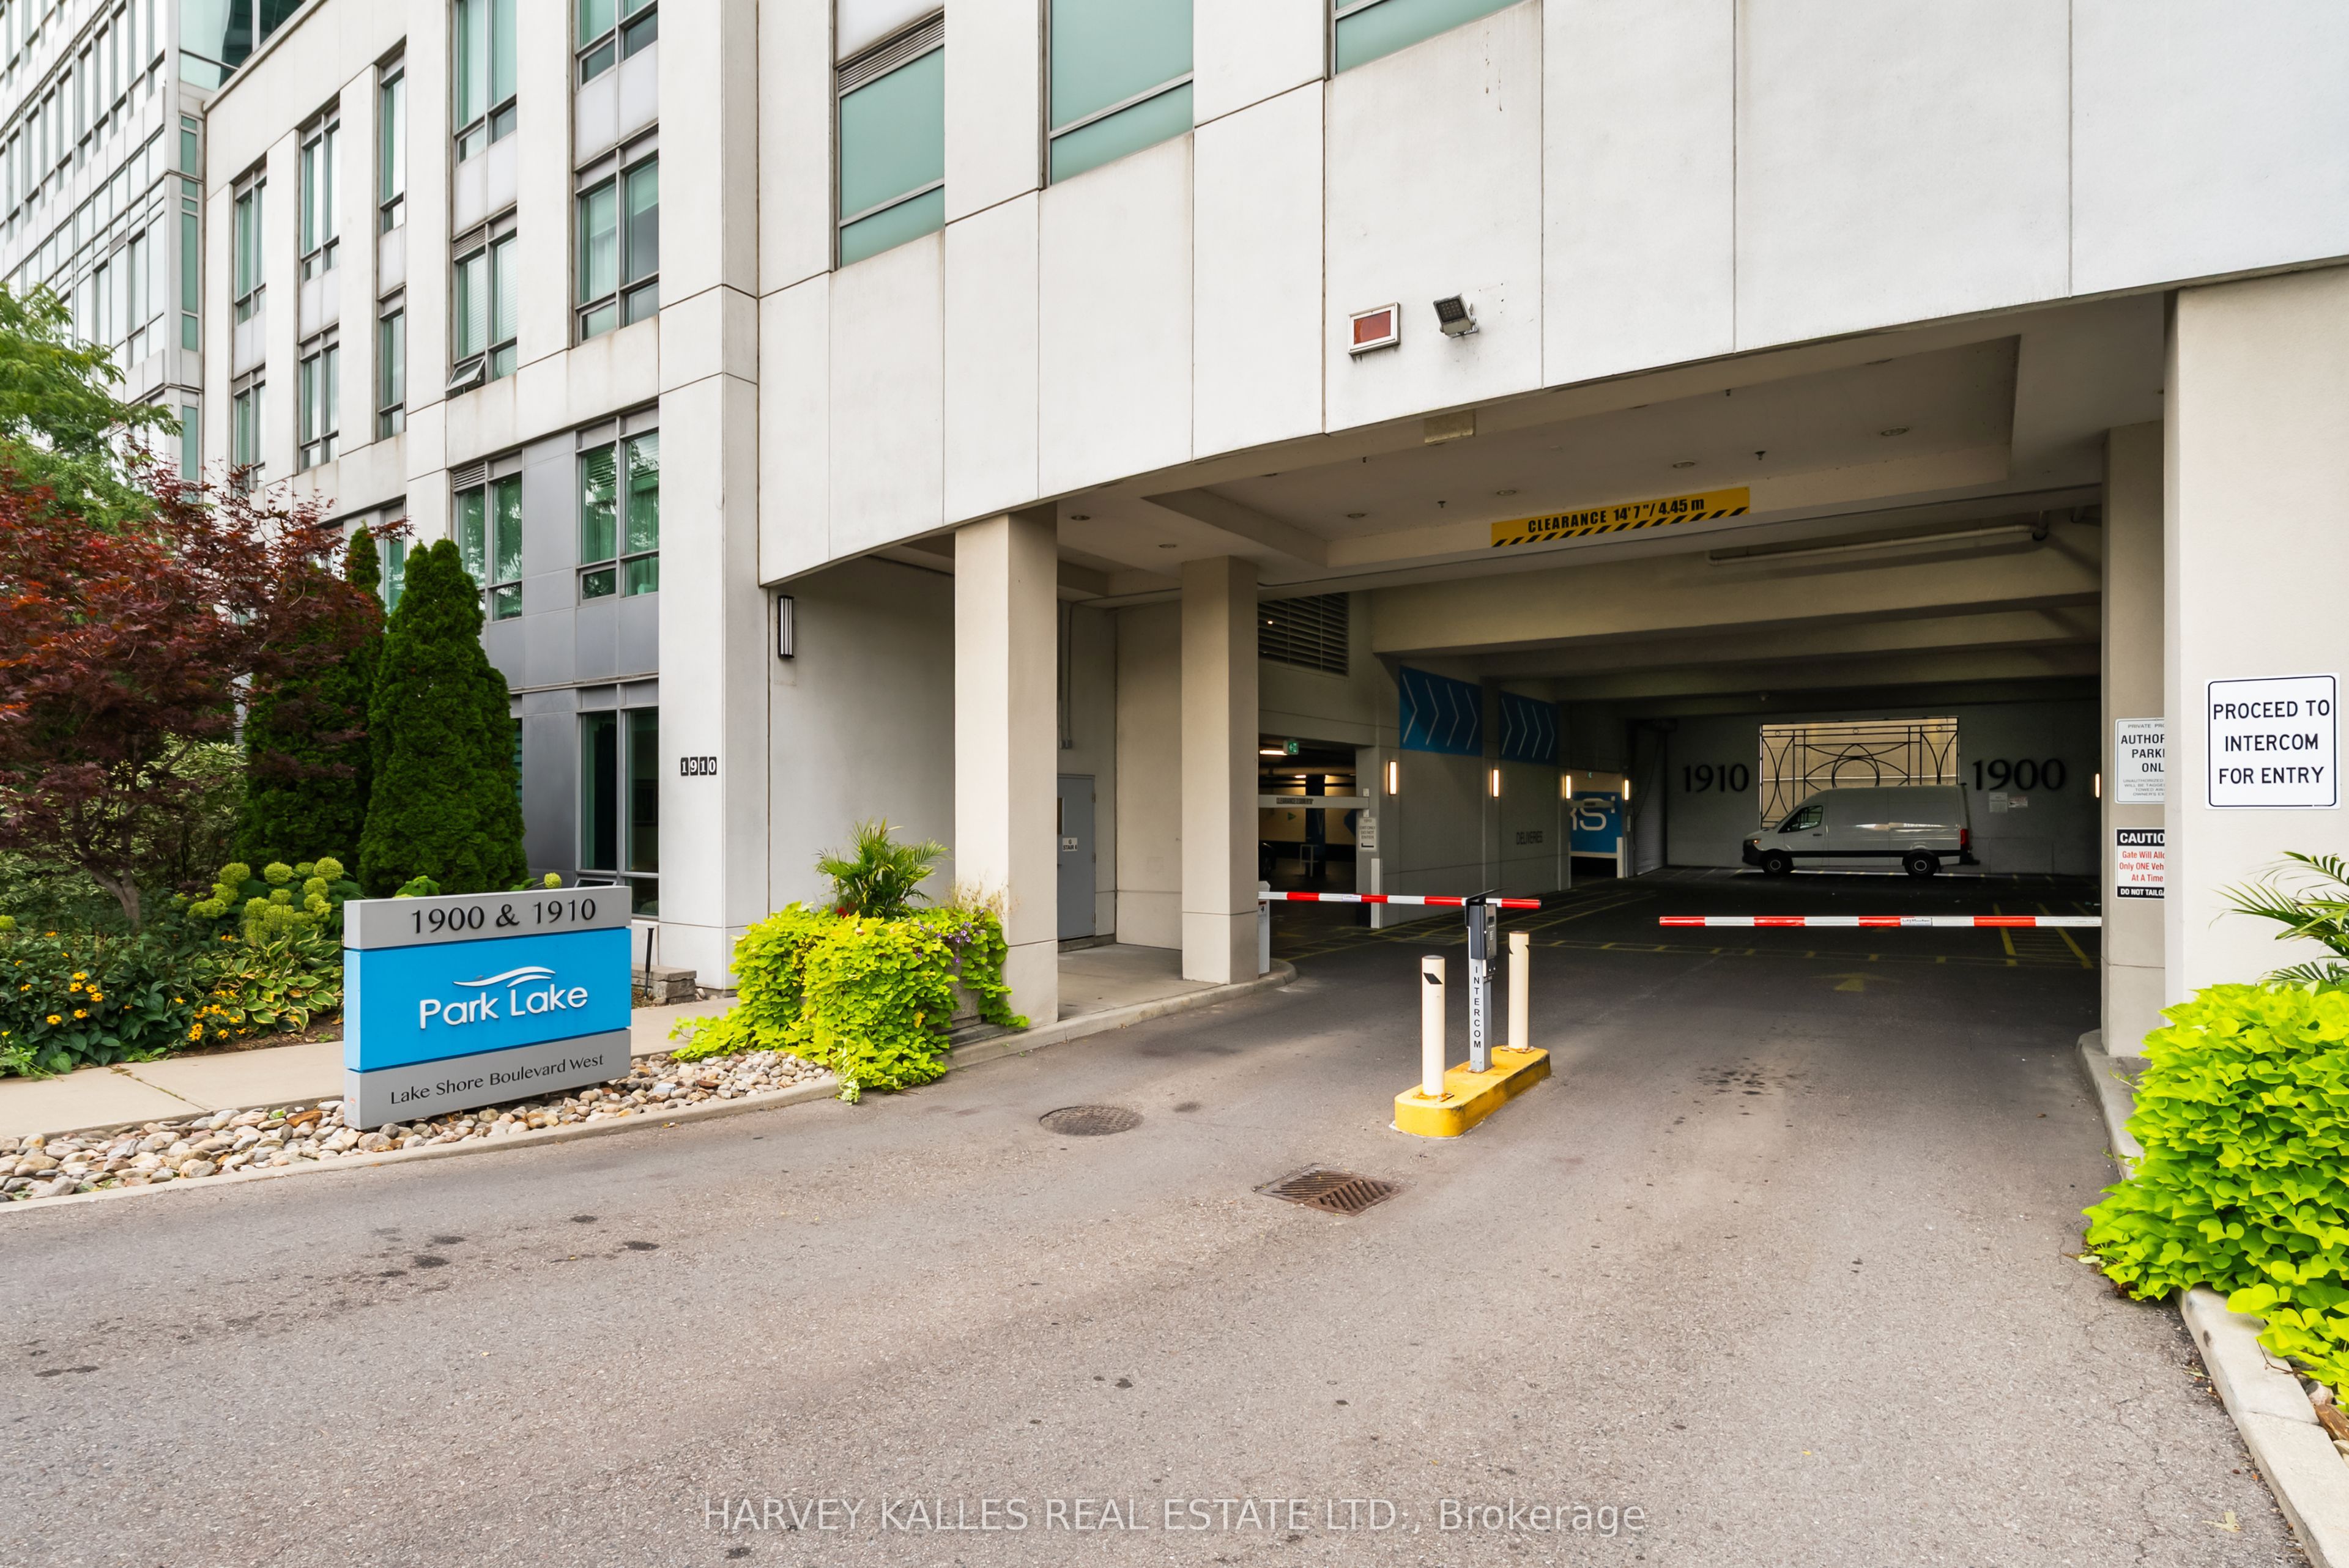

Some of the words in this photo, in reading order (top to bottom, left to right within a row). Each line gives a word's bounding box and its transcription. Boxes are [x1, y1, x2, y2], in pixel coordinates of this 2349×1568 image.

[1527, 510, 1607, 533] CLEARANCE
[2213, 701, 2298, 720] PROCEED
[2306, 699, 2330, 716] TO
[2225, 733, 2318, 752] INTERCOM
[681, 758, 716, 774] 1910
[1683, 764, 1750, 793] 1910
[1972, 758, 2066, 791] 1900
[2219, 768, 2254, 784] FOR
[2262, 766, 2325, 783] ENTRY
[2119, 862, 2134, 871] Only
[411, 906, 485, 934] 1900
[495, 904, 520, 928] &
[533, 898, 596, 925] 1910
[420, 991, 500, 1030] Park
[510, 984, 588, 1017] Lake
[1473, 966, 1482, 1049] INTERCOM
[392, 1085, 431, 1104] Lake
[436, 1078, 484, 1096] Shore
[490, 1059, 566, 1086] Boulevard
[570, 1054, 604, 1070] West
